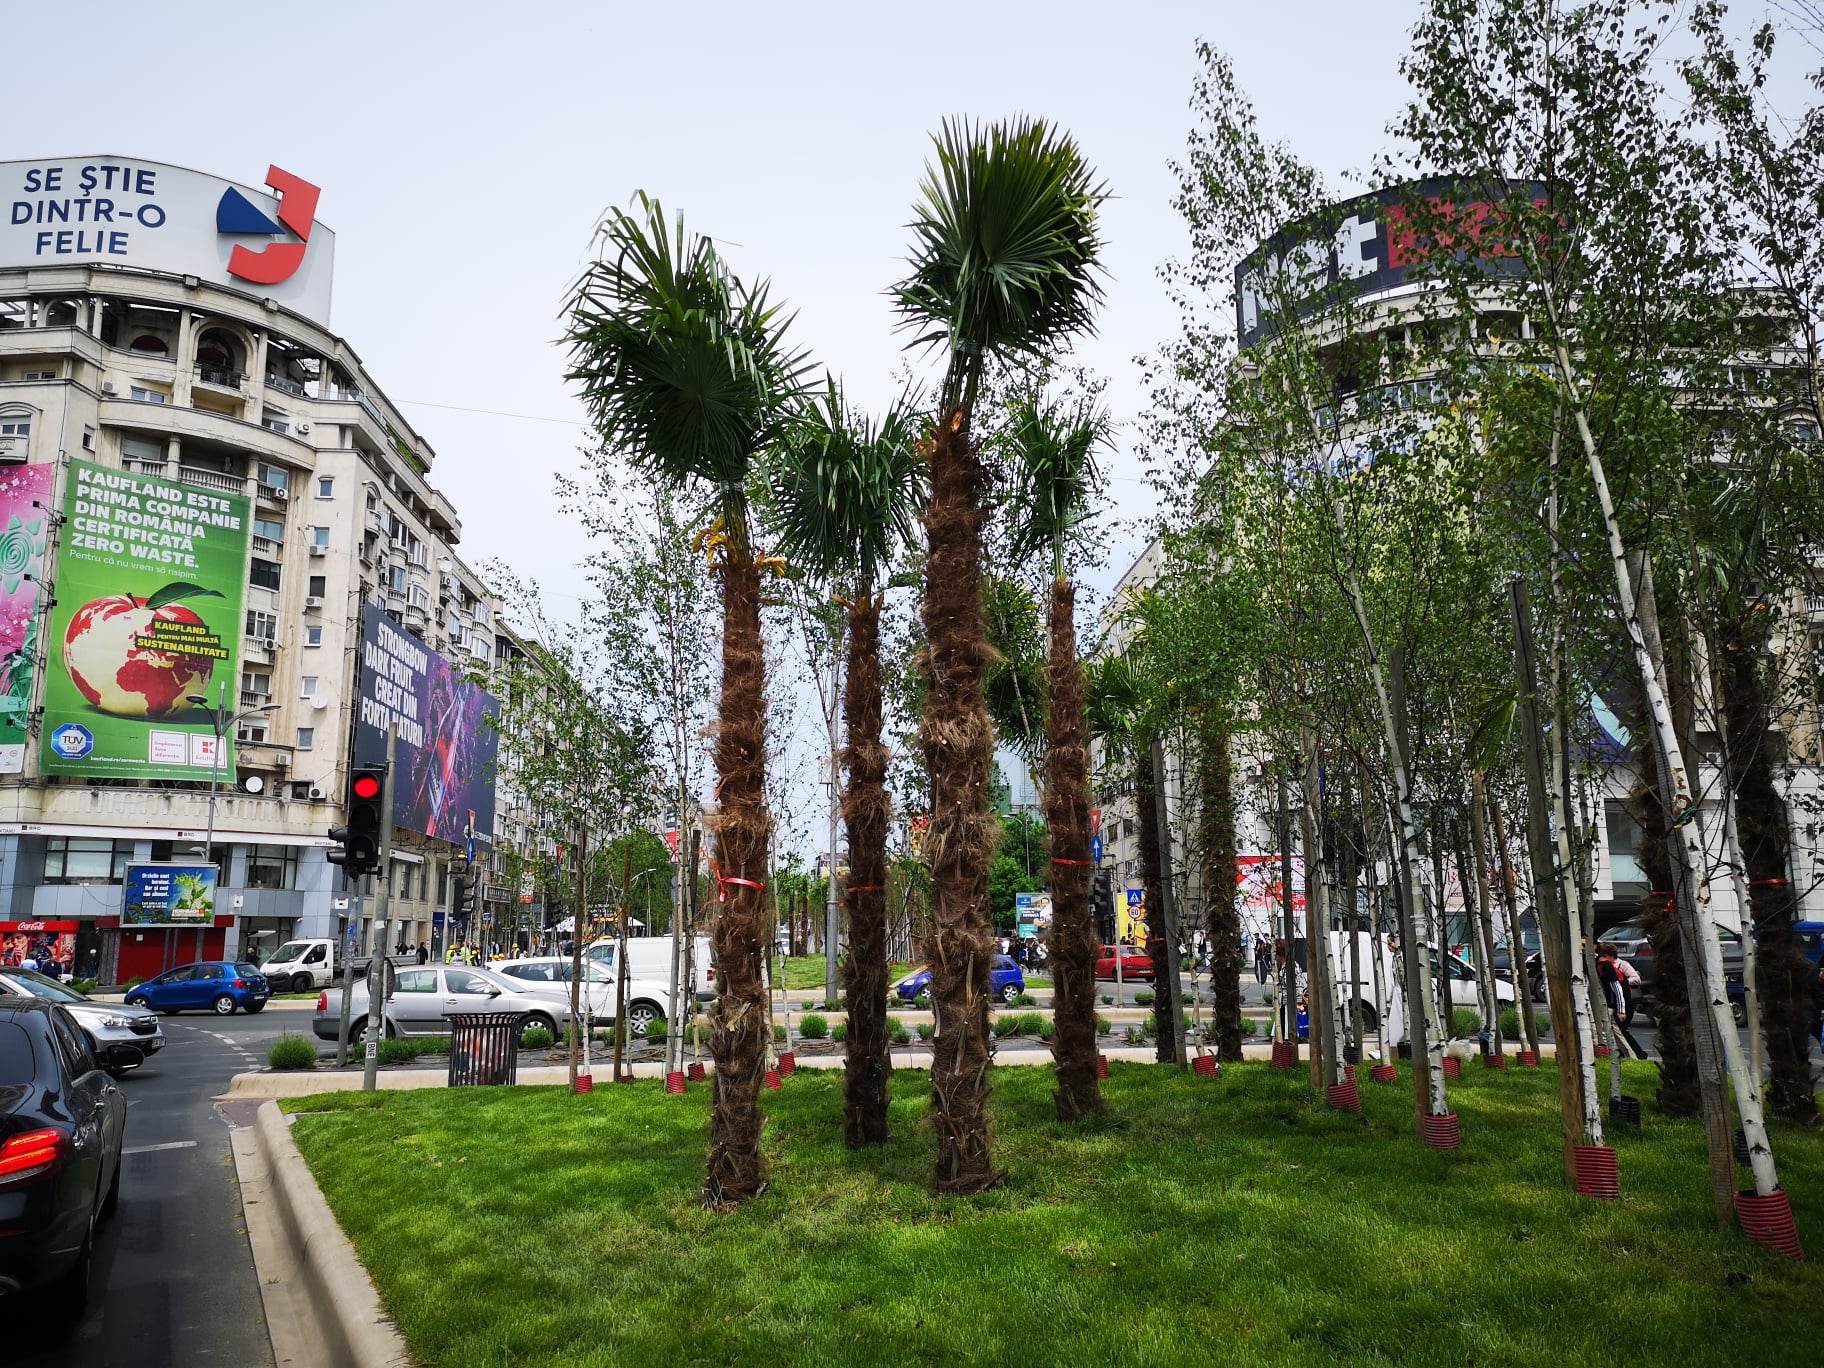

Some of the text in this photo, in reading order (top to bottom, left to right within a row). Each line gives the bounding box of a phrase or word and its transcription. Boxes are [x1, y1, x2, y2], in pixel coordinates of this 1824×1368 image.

[23, 167, 63, 193] SE
[11, 198, 166, 228] DINTR-O
[35, 231, 129, 255] FELIE
[76, 484, 241, 530] PRIMA COMPANIE
[78, 467, 231, 512] KAUFLAND ESTE
[73, 517, 194, 552] CERTIFICATĂ
[75, 500, 206, 539] DIN ROMÂNIA
[69, 549, 101, 563] Pentru
[117, 560, 129, 568] nu
[131, 563, 153, 573] vrem
[71, 533, 199, 568] ZERO WASTE.
[154, 621, 206, 635] KAUFLAND
[181, 634, 195, 643] MAI
[137, 638, 227, 658] SUSTENABILITATE
[365, 640, 390, 678] DARK
[378, 622, 427, 676] STRONGBOW
[375, 675, 418, 720] CREAT DIN
